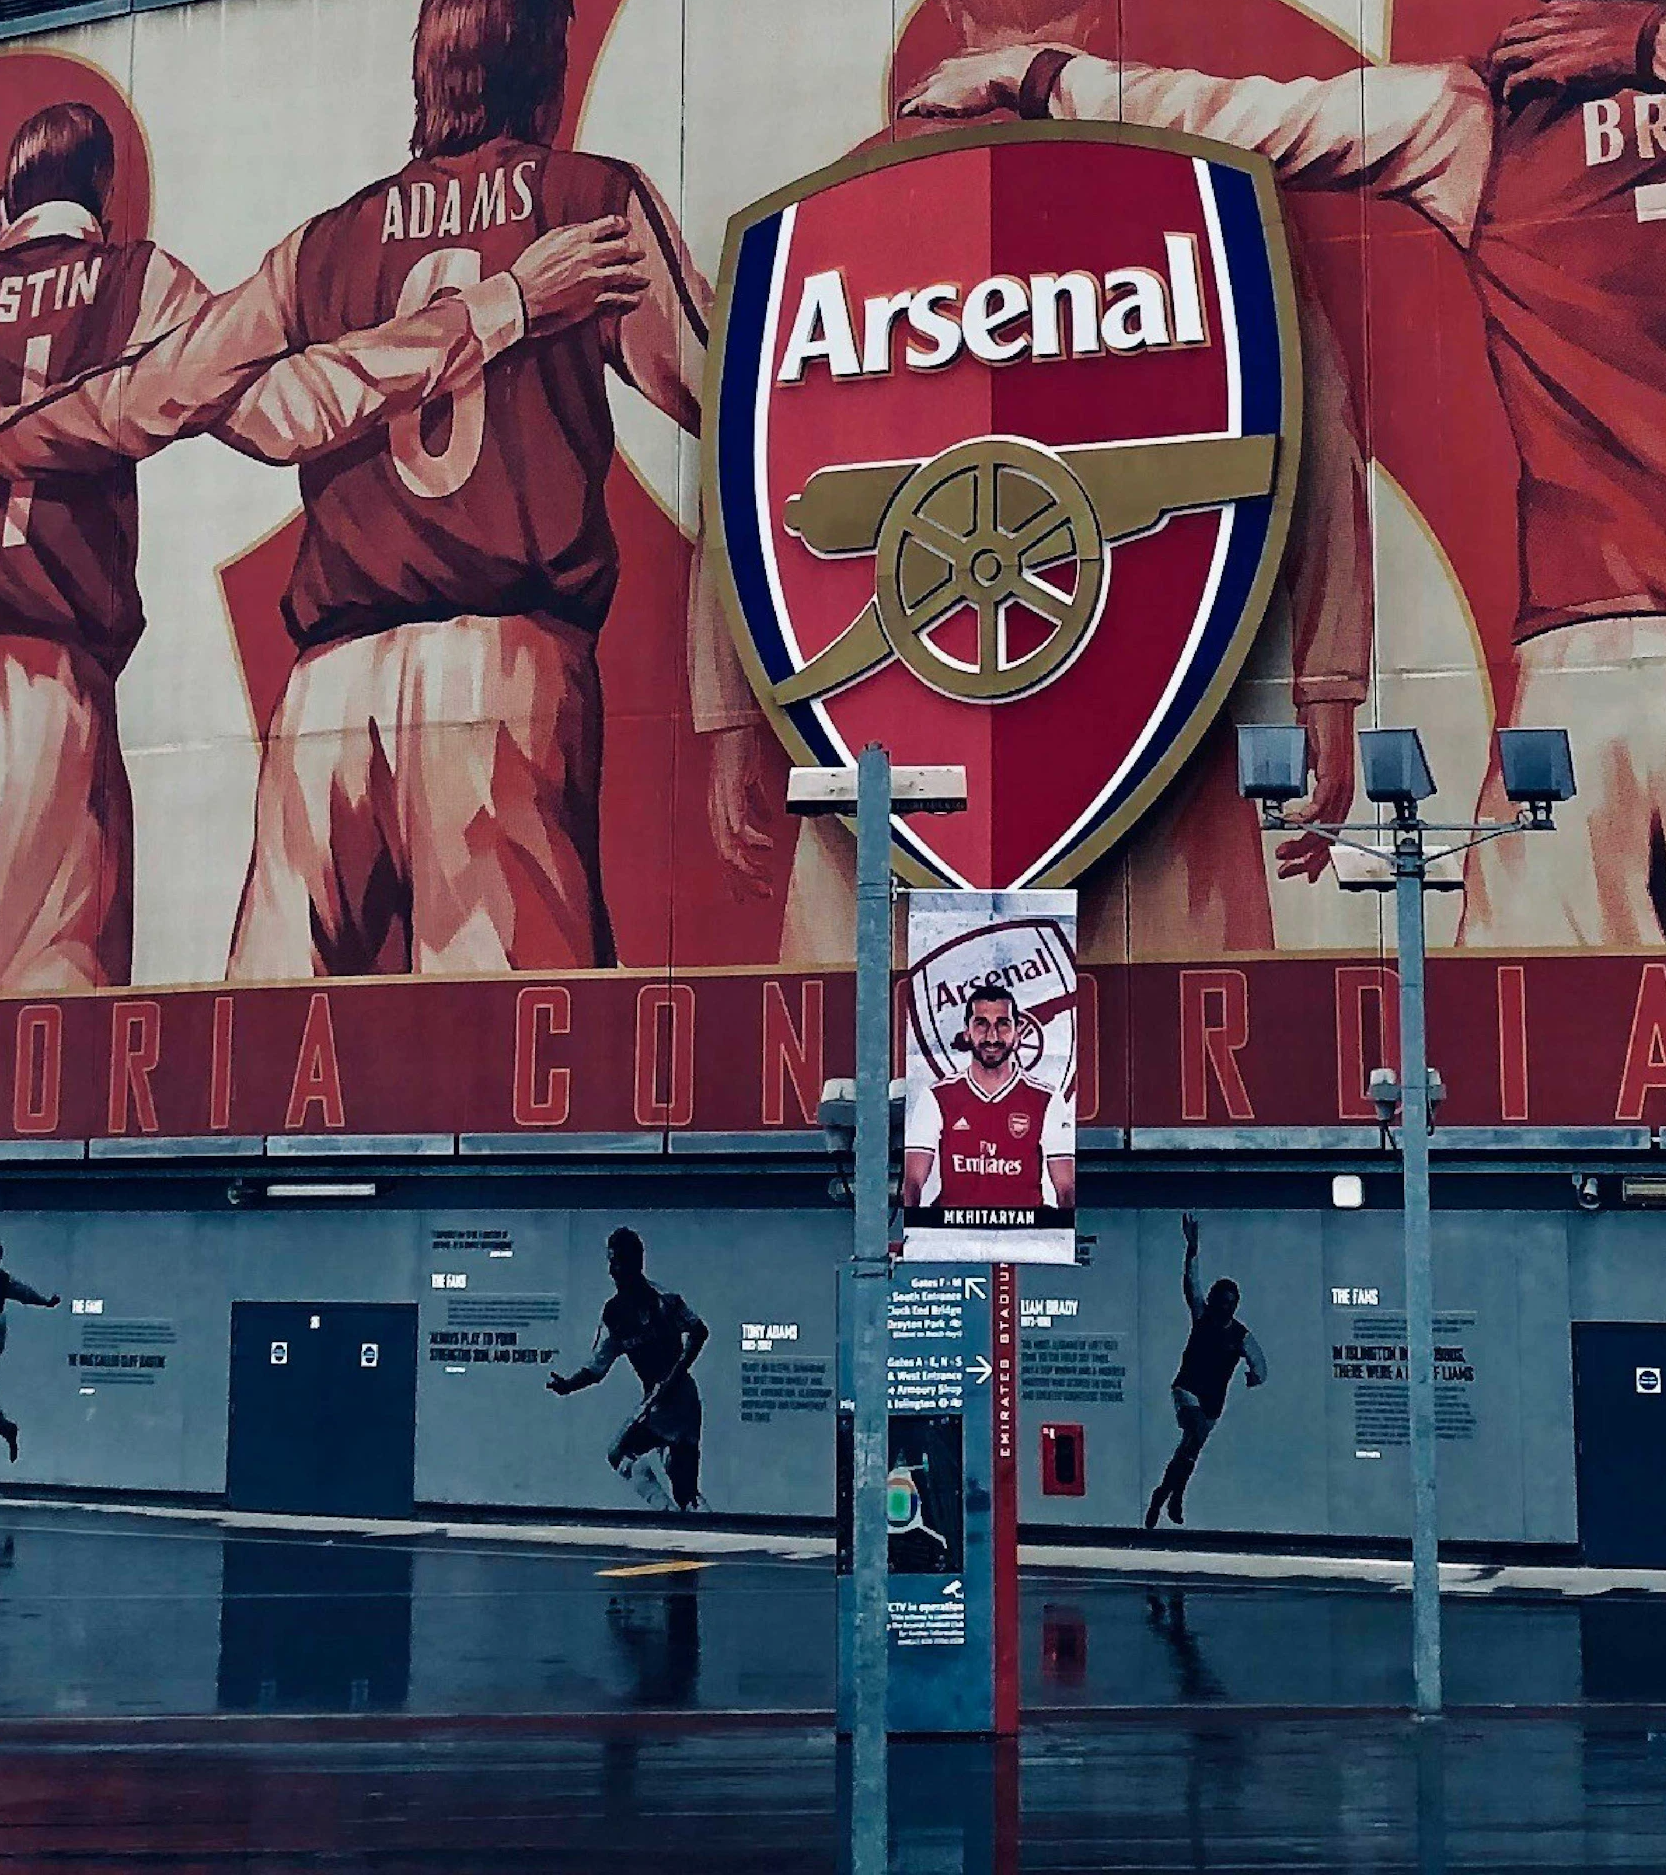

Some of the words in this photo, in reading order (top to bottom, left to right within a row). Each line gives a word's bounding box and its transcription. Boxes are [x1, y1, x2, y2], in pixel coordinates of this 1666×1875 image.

[381, 161, 536, 244] ADAMS
[776, 231, 1213, 387] Arsenal
[936, 947, 1052, 1012] Arsenal
[951, 1154, 1022, 1176] Emirates
[943, 1209, 1035, 1225] MKHITARYAN
[892, 1292, 920, 1302] South
[922, 1292, 962, 1302] Entrance
[1331, 1289, 1350, 1305] THE
[1351, 1289, 1379, 1305] FANS
[1021, 1300, 1044, 1315] LIAM
[1045, 1300, 1079, 1315] BRADY
[741, 1324, 765, 1339] TONY
[765, 1324, 797, 1339] ADAMS
[897, 1372, 921, 1381] West
[999, 1359, 1011, 1457] EMIRATES
